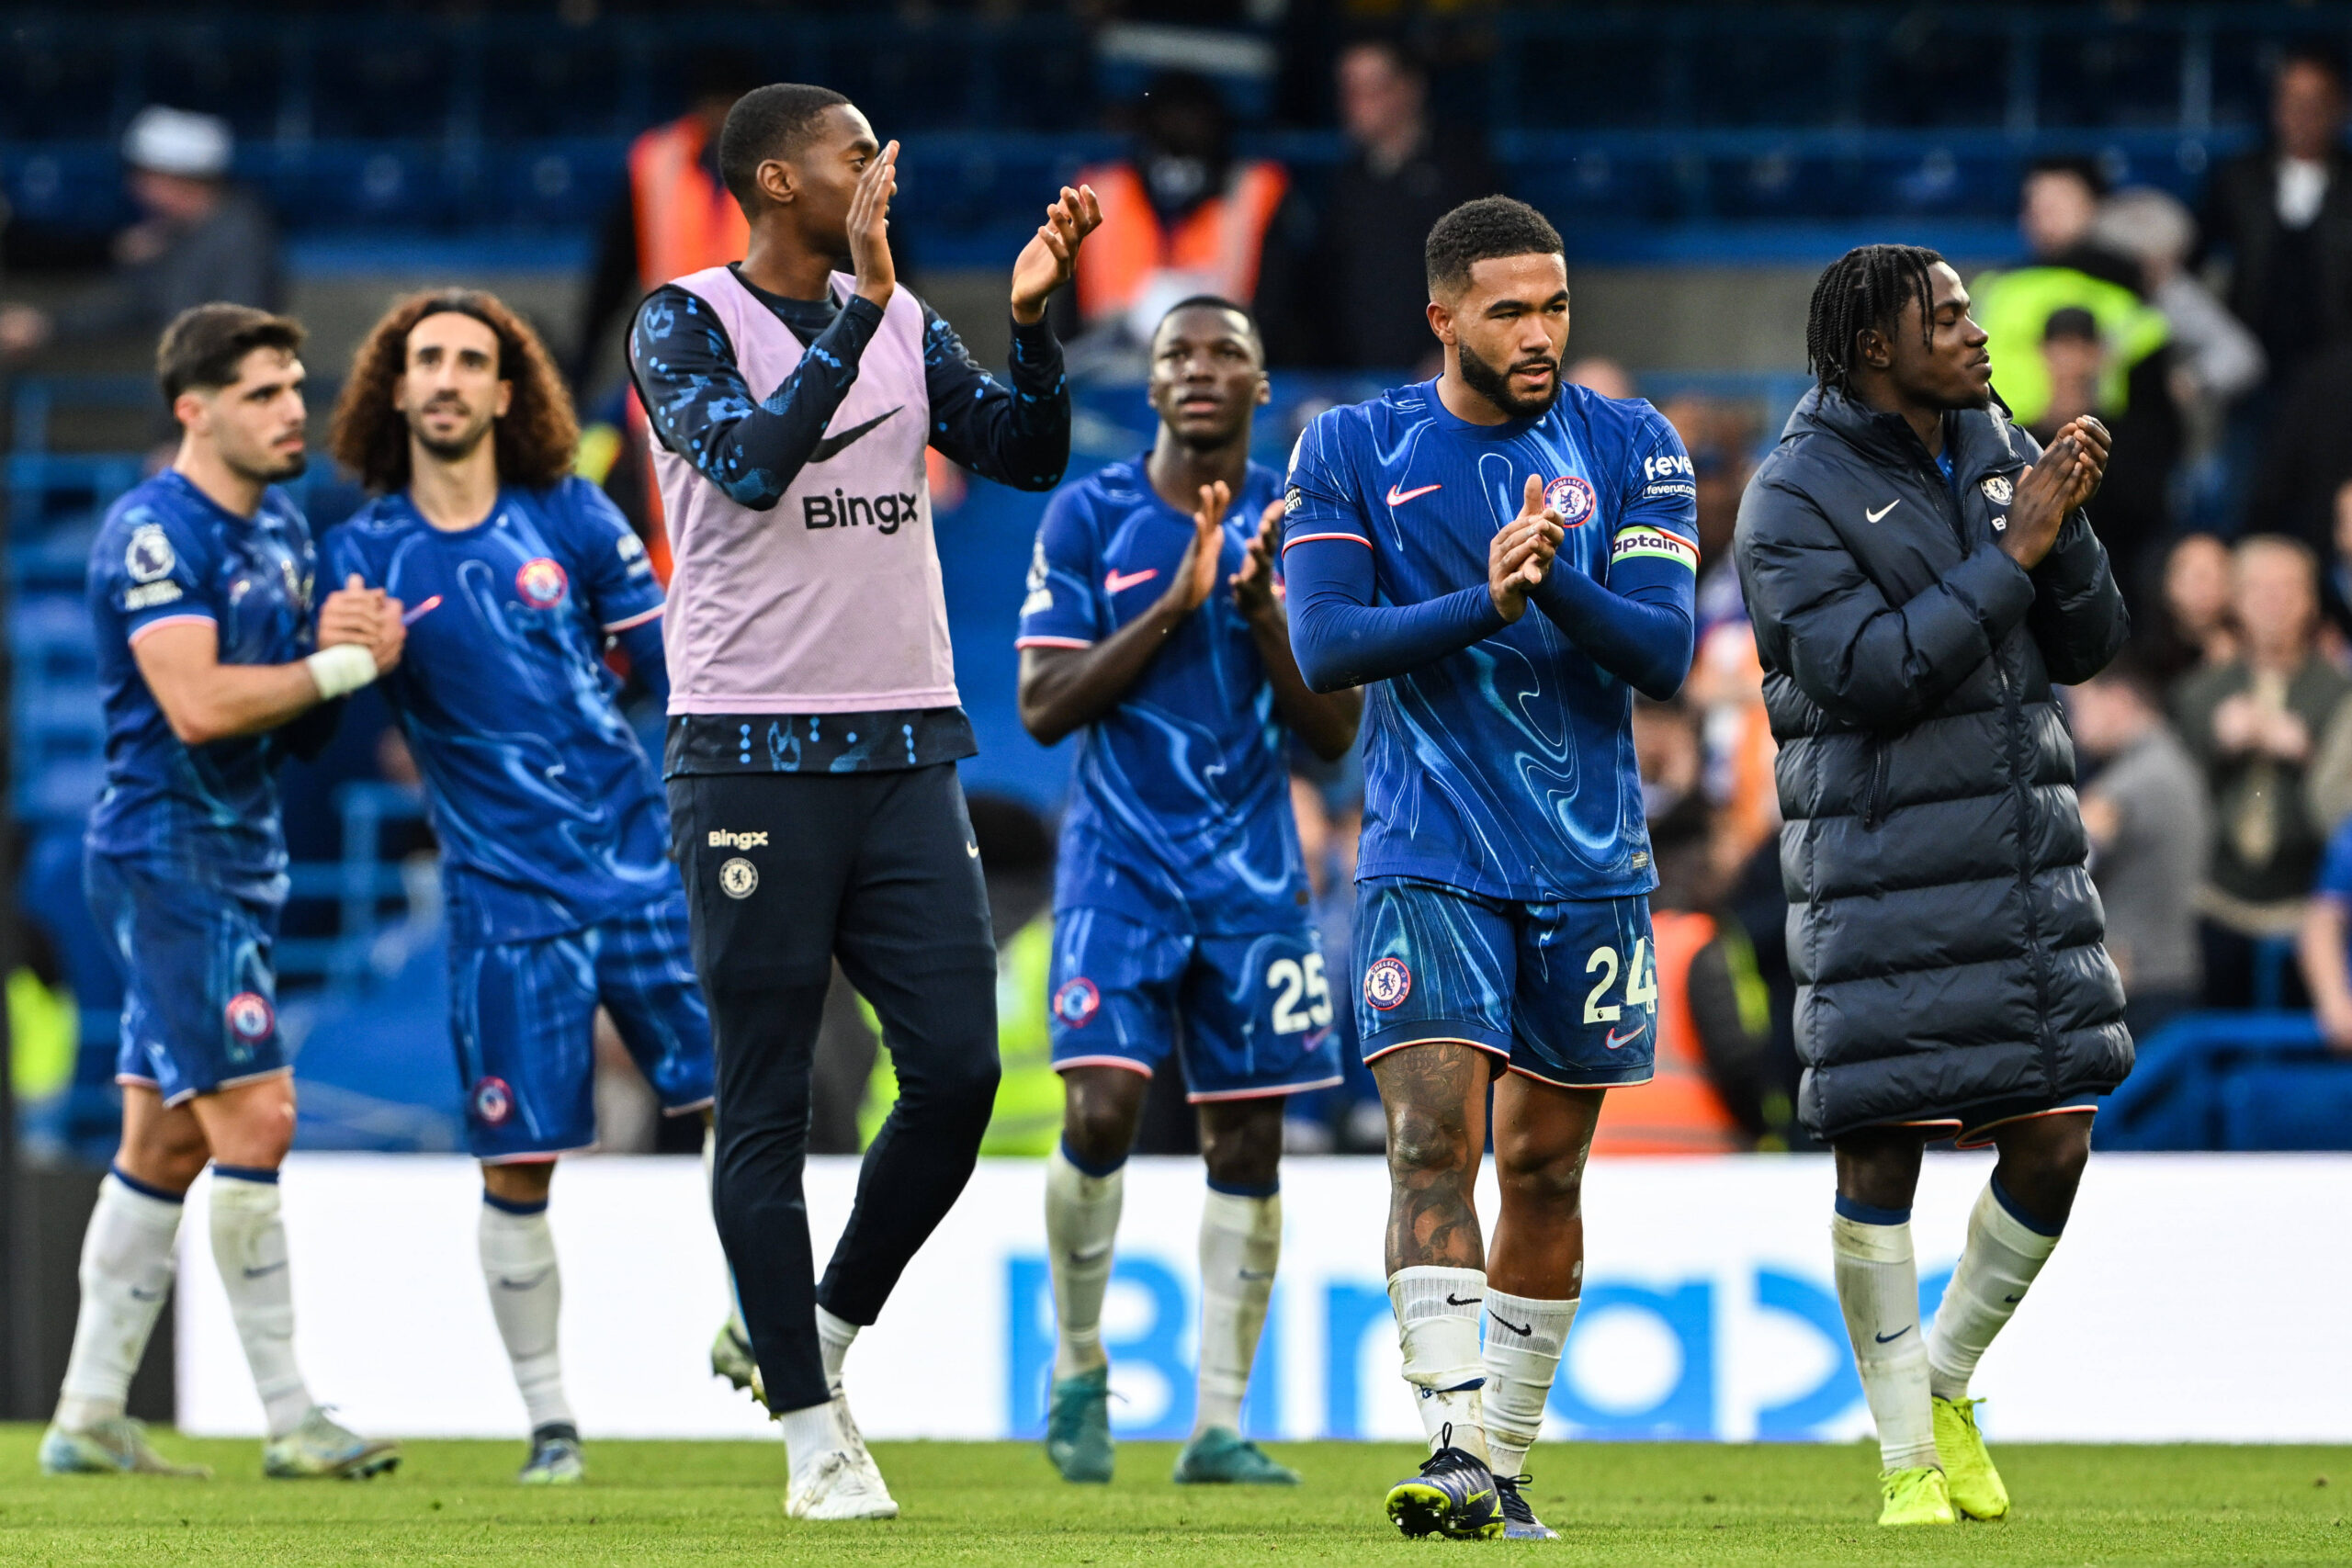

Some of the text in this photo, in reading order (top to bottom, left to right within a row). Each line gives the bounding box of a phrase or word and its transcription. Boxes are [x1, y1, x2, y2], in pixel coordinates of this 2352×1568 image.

[1645, 455, 1695, 480] feve
[803, 488, 918, 535] Bingx
[1613, 535, 1679, 554] aptain
[708, 829, 768, 851] Bingx
[1266, 953, 1334, 1035] 25
[1583, 937, 1657, 1024] 24
